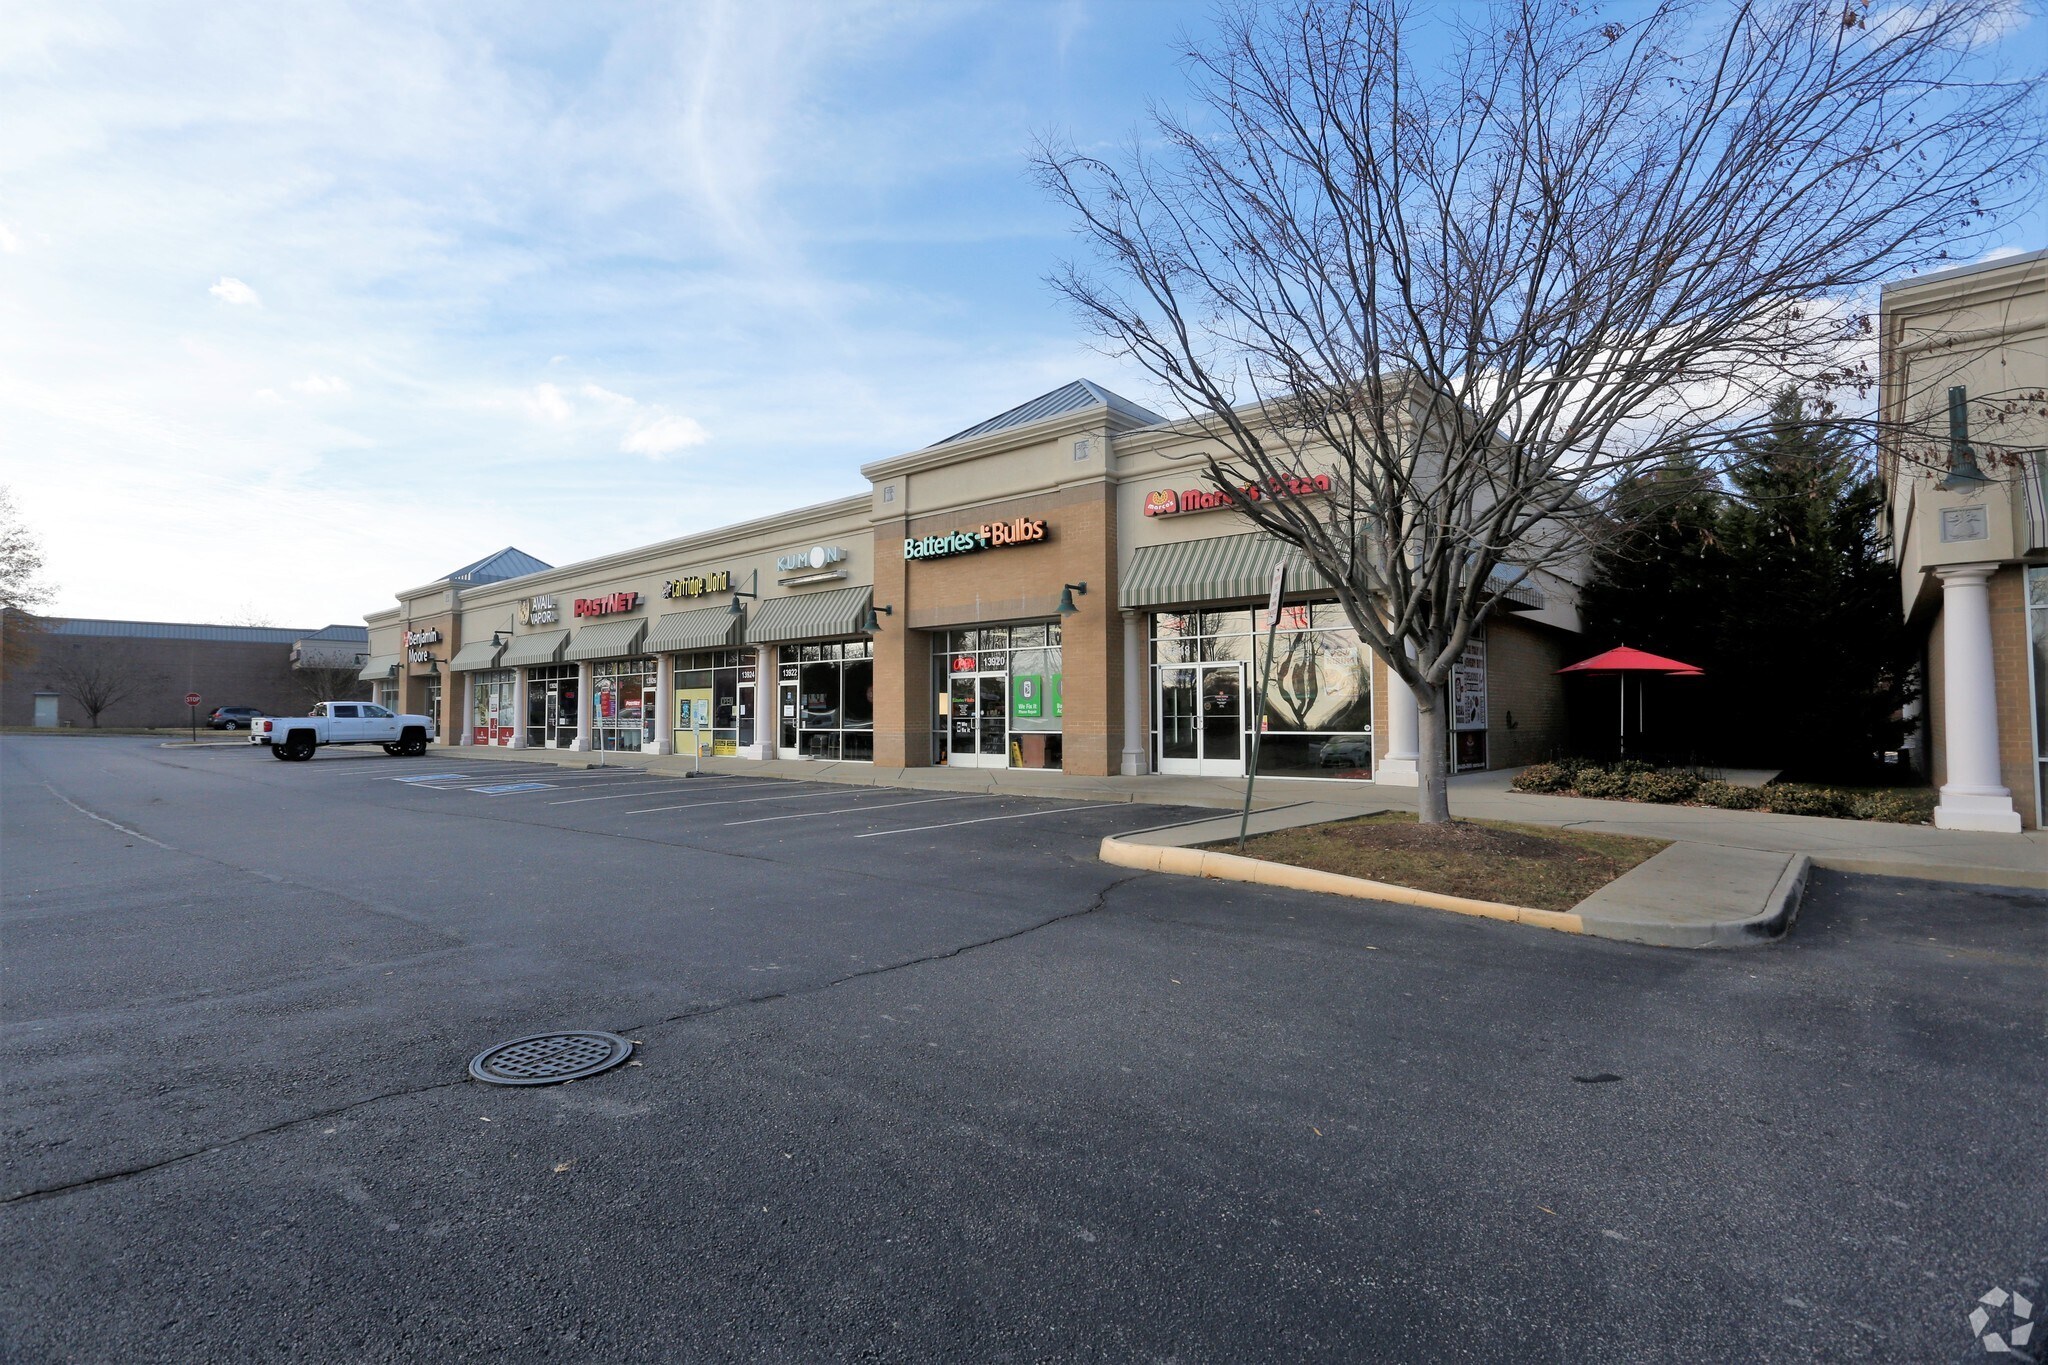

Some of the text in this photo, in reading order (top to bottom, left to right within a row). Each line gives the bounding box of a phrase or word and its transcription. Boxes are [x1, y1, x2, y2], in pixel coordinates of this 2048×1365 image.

[904, 530, 974, 559] Batteries
[992, 517, 1044, 546] Bulbs
[777, 546, 837, 572] KUMON
[672, 571, 727, 597] Cartridge World
[532, 594, 552, 611] AVAIL
[530, 611, 552, 625] VAPOR
[408, 627, 437, 648] Benjamin
[408, 648, 428, 663] Moore
[983, 657, 1005, 666] 13920
